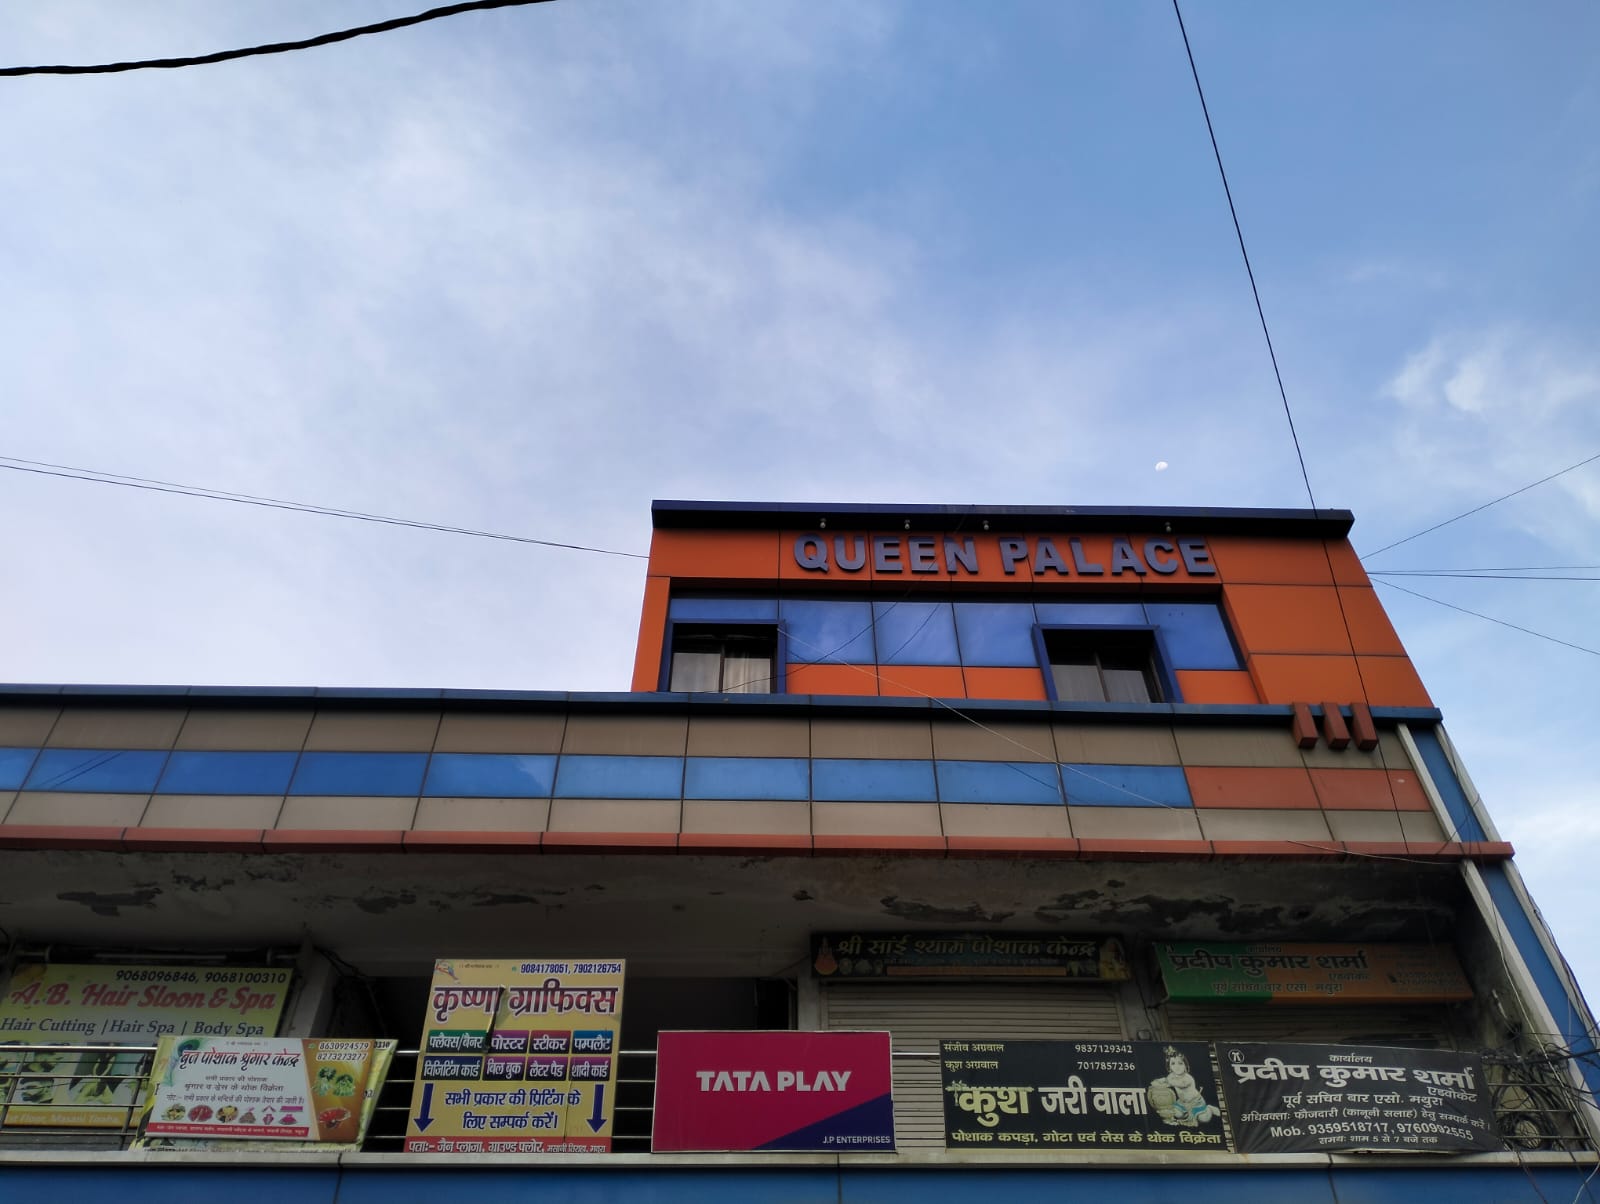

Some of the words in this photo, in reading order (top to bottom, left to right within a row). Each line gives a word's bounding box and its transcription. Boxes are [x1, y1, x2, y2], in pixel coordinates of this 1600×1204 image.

[794, 535, 979, 575] QUEEN
[999, 536, 1216, 577] PALACE
[837, 935, 862, 956] श्री
[1168, 949, 1233, 971] प्रदीप
[1238, 953, 1311, 977] कुमार
[1316, 950, 1369, 970] शर्मा
[204, 971, 287, 984] 9068100310
[81, 983, 138, 1007] Hair
[208, 986, 228, 1009] &
[229, 985, 276, 1015] Spa
[432, 986, 504, 1023] कृष्णा
[508, 977, 619, 1017] ग्राफिक्स
[0, 1017, 36, 1031] Hair
[39, 1018, 97, 1036] Cutting
[109, 1019, 144, 1033] Hair
[146, 1020, 175, 1037] Spa
[192, 1021, 232, 1037] Body
[235, 1022, 265, 1037] Spa
[319, 1042, 369, 1050] 8630924579
[490, 1033, 526, 1051] पोस्टर
[532, 1034, 567, 1051] स्टीकर
[972, 1043, 1004, 1053] अग्रवाल
[1074, 1043, 1133, 1054] 9837129342
[201, 1046, 241, 1066] पोशाक
[272, 1047, 301, 1068] केन्द्र
[944, 1060, 963, 1071] कुश
[965, 1060, 999, 1070] अग्रवाल
[1077, 1062, 1136, 1071] 7017857236
[1329, 1052, 1373, 1064] कार्यालय
[461, 1060, 481, 1078] कार्ड
[486, 1058, 504, 1075] बिल
[505, 1061, 522, 1079] बुक
[550, 1060, 564, 1078] पैड
[571, 1061, 590, 1078] शादी
[590, 1061, 609, 1078] कार्ड
[1231, 1057, 1310, 1084] प्रदीप
[1316, 1064, 1407, 1088] कुमार
[1413, 1066, 1475, 1090] शर्मा
[695, 1070, 771, 1092] TATA
[777, 1070, 852, 1092] PLAY
[445, 1088, 472, 1106] सभी
[474, 1091, 505, 1107] प्रकार
[508, 1088, 526, 1106] की
[566, 1088, 582, 1106] के
[957, 1086, 1034, 1128] कुश
[1038, 1075, 1088, 1116] जरी
[1091, 1087, 1148, 1116] वाला
[1281, 1092, 1302, 1108] पूर्व
[1306, 1091, 1342, 1103] सचिव
[1347, 1093, 1369, 1104] बार
[1409, 1095, 1443, 1109] मथुरा
[1426, 1085, 1478, 1103] एडवोकेट
[462, 1110, 487, 1130] लिए
[489, 1110, 530, 1130] सम्पर्क
[532, 1110, 558, 1129] करें।
[1294, 1107, 1338, 1119] फौजदारी
[1383, 1108, 1418, 1119] सलाह)
[1421, 1107, 1437, 1123] हेतु
[1439, 1111, 1469, 1125] सम्पर्क
[836, 1135, 891, 1144] ENTERPRISES
[951, 1129, 993, 1143] पोशाक
[1043, 1130, 1074, 1143] गोटा
[1078, 1129, 1097, 1143] एवं
[1101, 1129, 1125, 1143] लेस
[1129, 1130, 1143, 1144] के
[1147, 1130, 1175, 1144] थोक
[1179, 1129, 1221, 1145] विक्रेता
[1270, 1125, 1305, 1138] Mob.
[1396, 1122, 1474, 1141] 9760992555
[1350, 1136, 1370, 1144] शाम
[1372, 1136, 1379, 1144] 5
[1382, 1134, 1391, 1144] से
[1394, 1136, 1400, 1144] 7
[1403, 1134, 1418, 1144] बजे
[1421, 1136, 1438, 1145] तक
